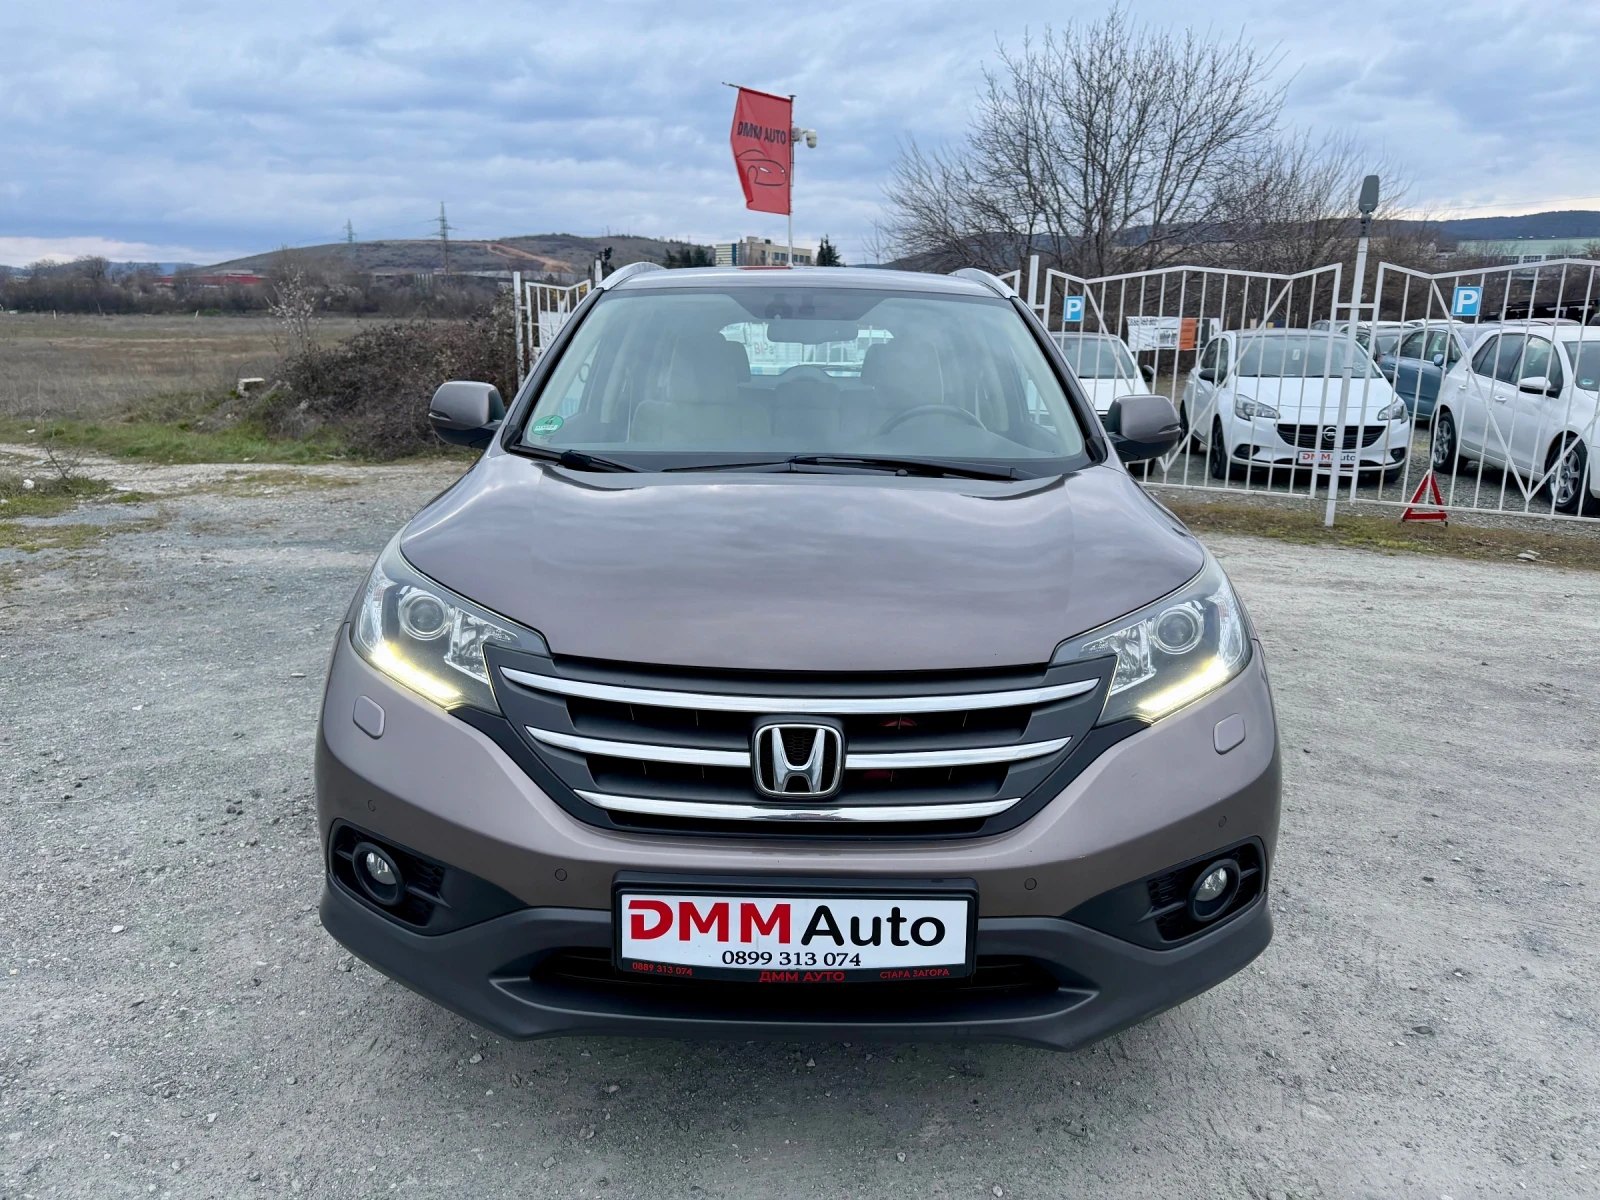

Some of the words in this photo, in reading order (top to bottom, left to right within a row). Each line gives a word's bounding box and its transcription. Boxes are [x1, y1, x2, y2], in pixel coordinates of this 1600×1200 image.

[737, 121, 762, 140] DMM
[764, 128, 787, 145] AUTO
[1066, 299, 1082, 319] P
[1456, 290, 1479, 312] P
[628, 899, 791, 944] DMM
[800, 904, 946, 947] Auto
[721, 950, 773, 966] 0899
[779, 951, 817, 967] 313
[823, 952, 862, 967] 074
[632, 962, 654, 972] 0889
[656, 965, 674, 974] 313
[675, 967, 693, 976] 074
[758, 971, 799, 983] ДММ
[802, 970, 846, 982] АУТО
[879, 969, 911, 979] СТАРА
[913, 968, 950, 978] ЗАГОРА
